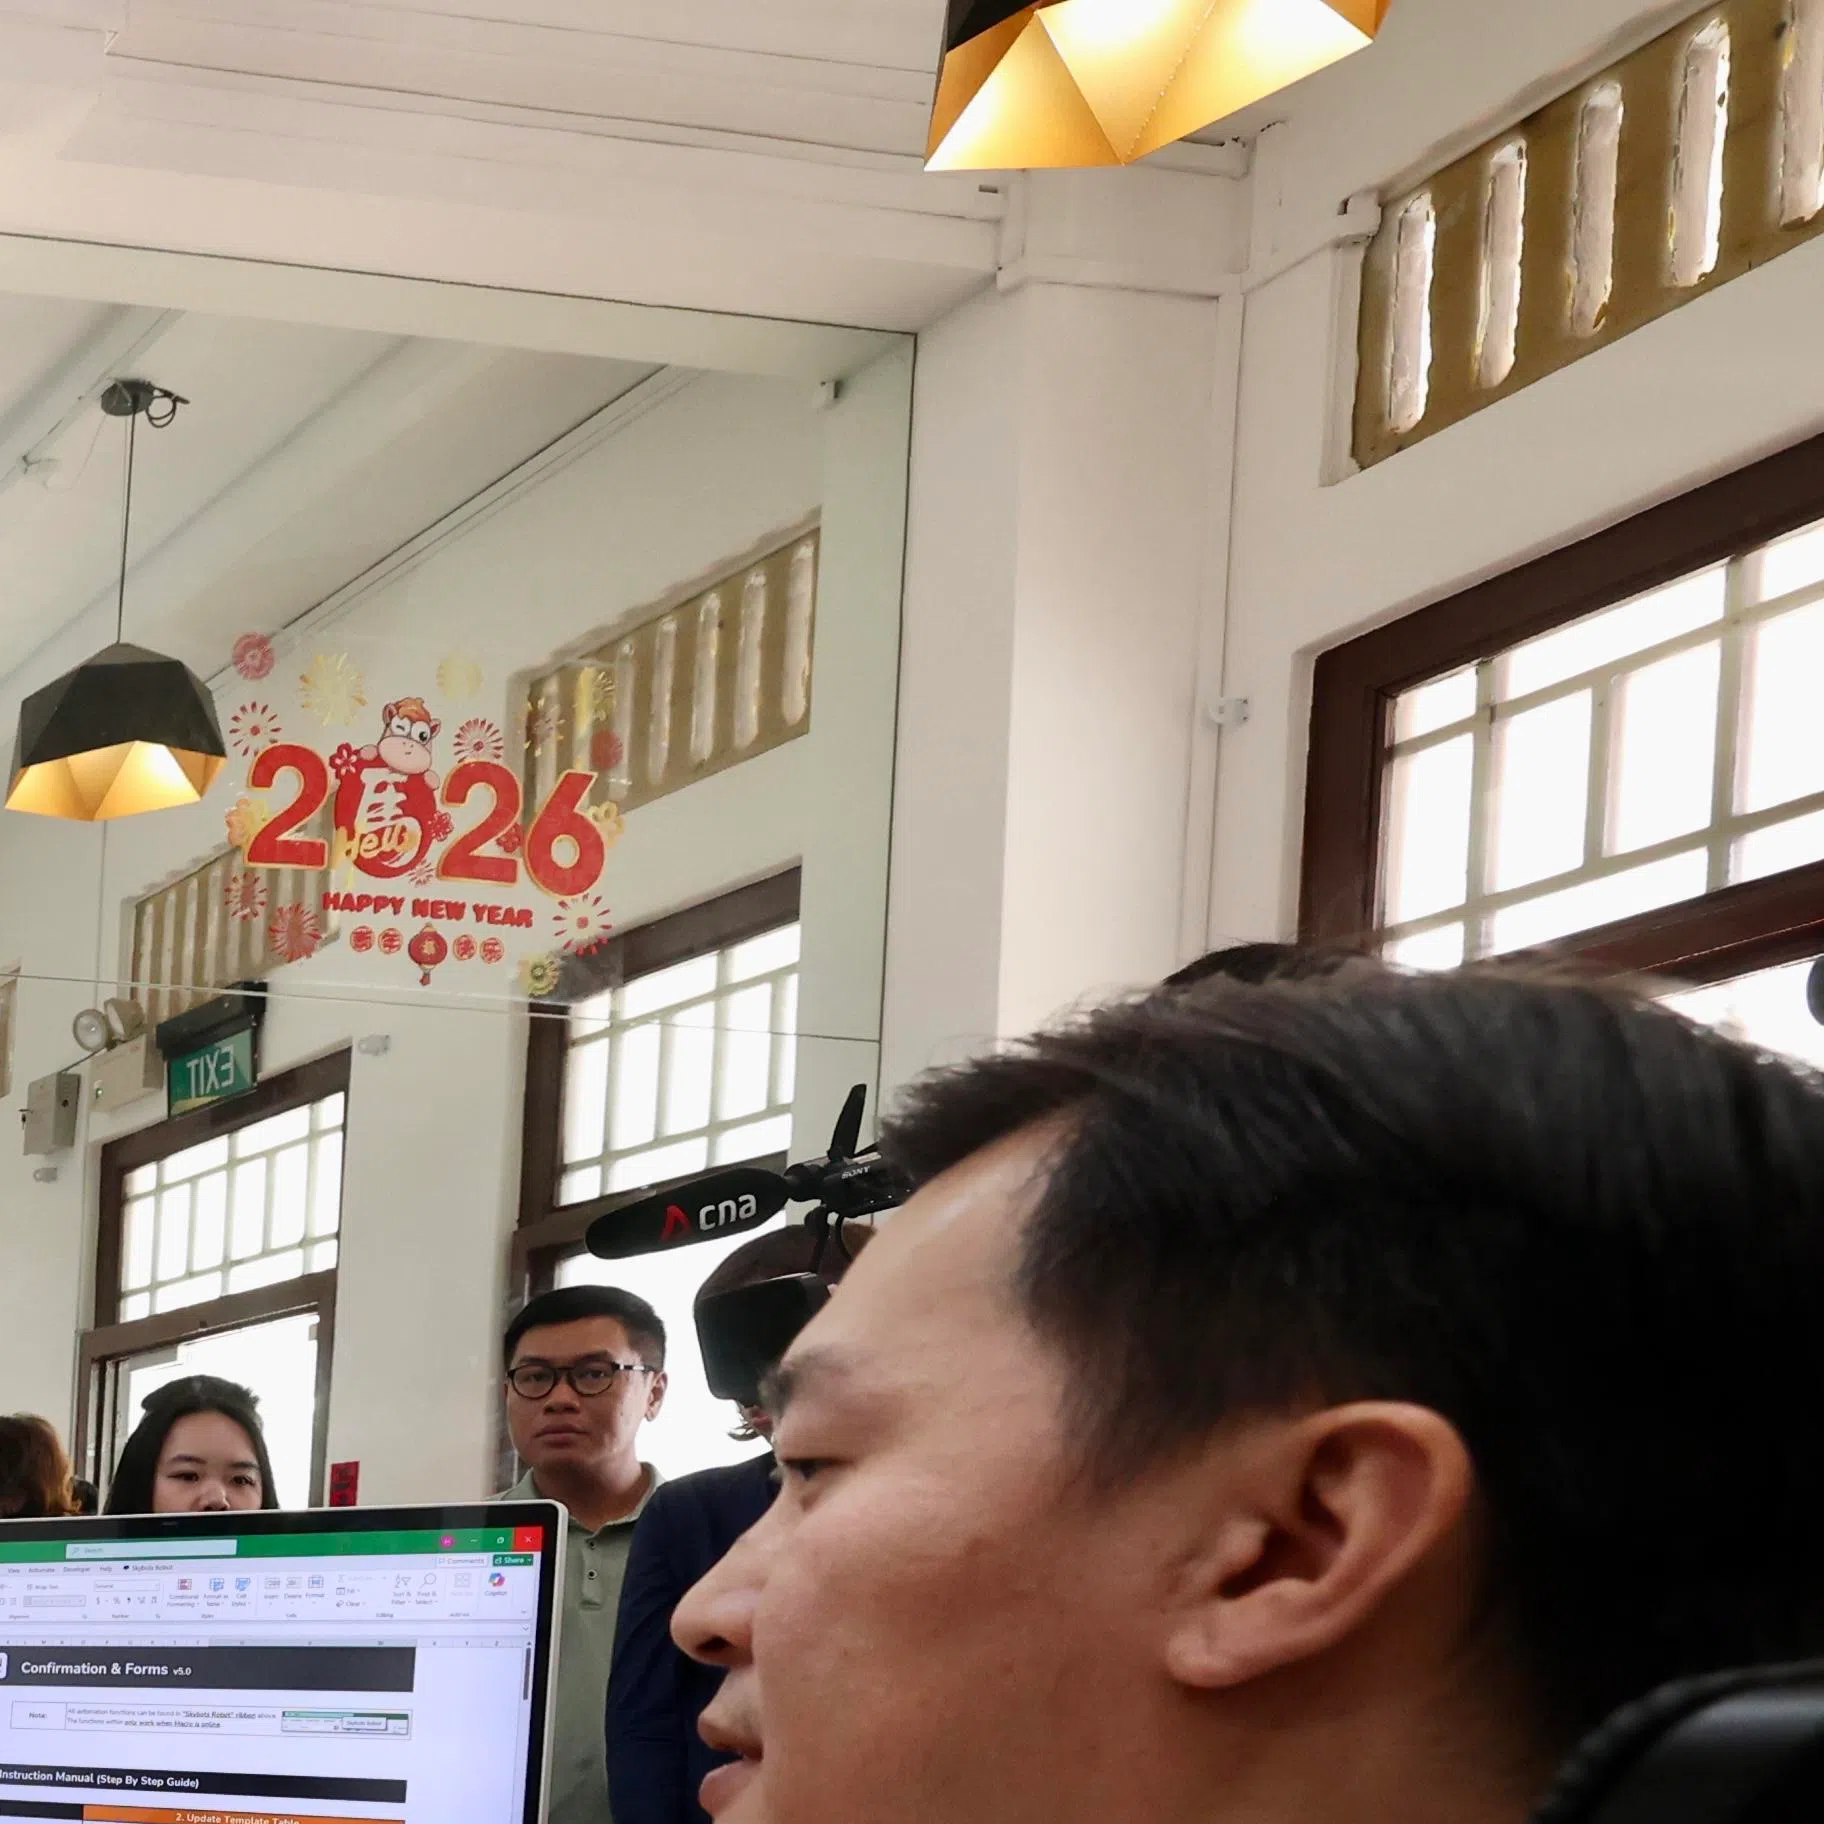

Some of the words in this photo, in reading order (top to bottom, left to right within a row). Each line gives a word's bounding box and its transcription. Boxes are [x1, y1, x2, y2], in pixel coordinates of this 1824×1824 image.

[323, 891, 404, 916] HAPPY
[411, 897, 465, 922] NEW
[472, 902, 534, 928] YEAR
[841, 1165, 871, 1179] SONY
[699, 1194, 757, 1231] cna
[21, 1661, 106, 1675] Confirmation
[111, 1663, 121, 1675] &
[125, 1663, 168, 1676] Forms
[173, 1667, 192, 1676] v5.0
[28, 1711, 47, 1719] Note:
[0, 1769, 52, 1781] Instruction
[55, 1771, 94, 1783] Manual
[97, 1775, 123, 1787] (Step
[126, 1776, 138, 1787] By
[141, 1776, 164, 1788] Step
[166, 1777, 199, 1789] Guide)
[176, 1813, 184, 1822] 2.
